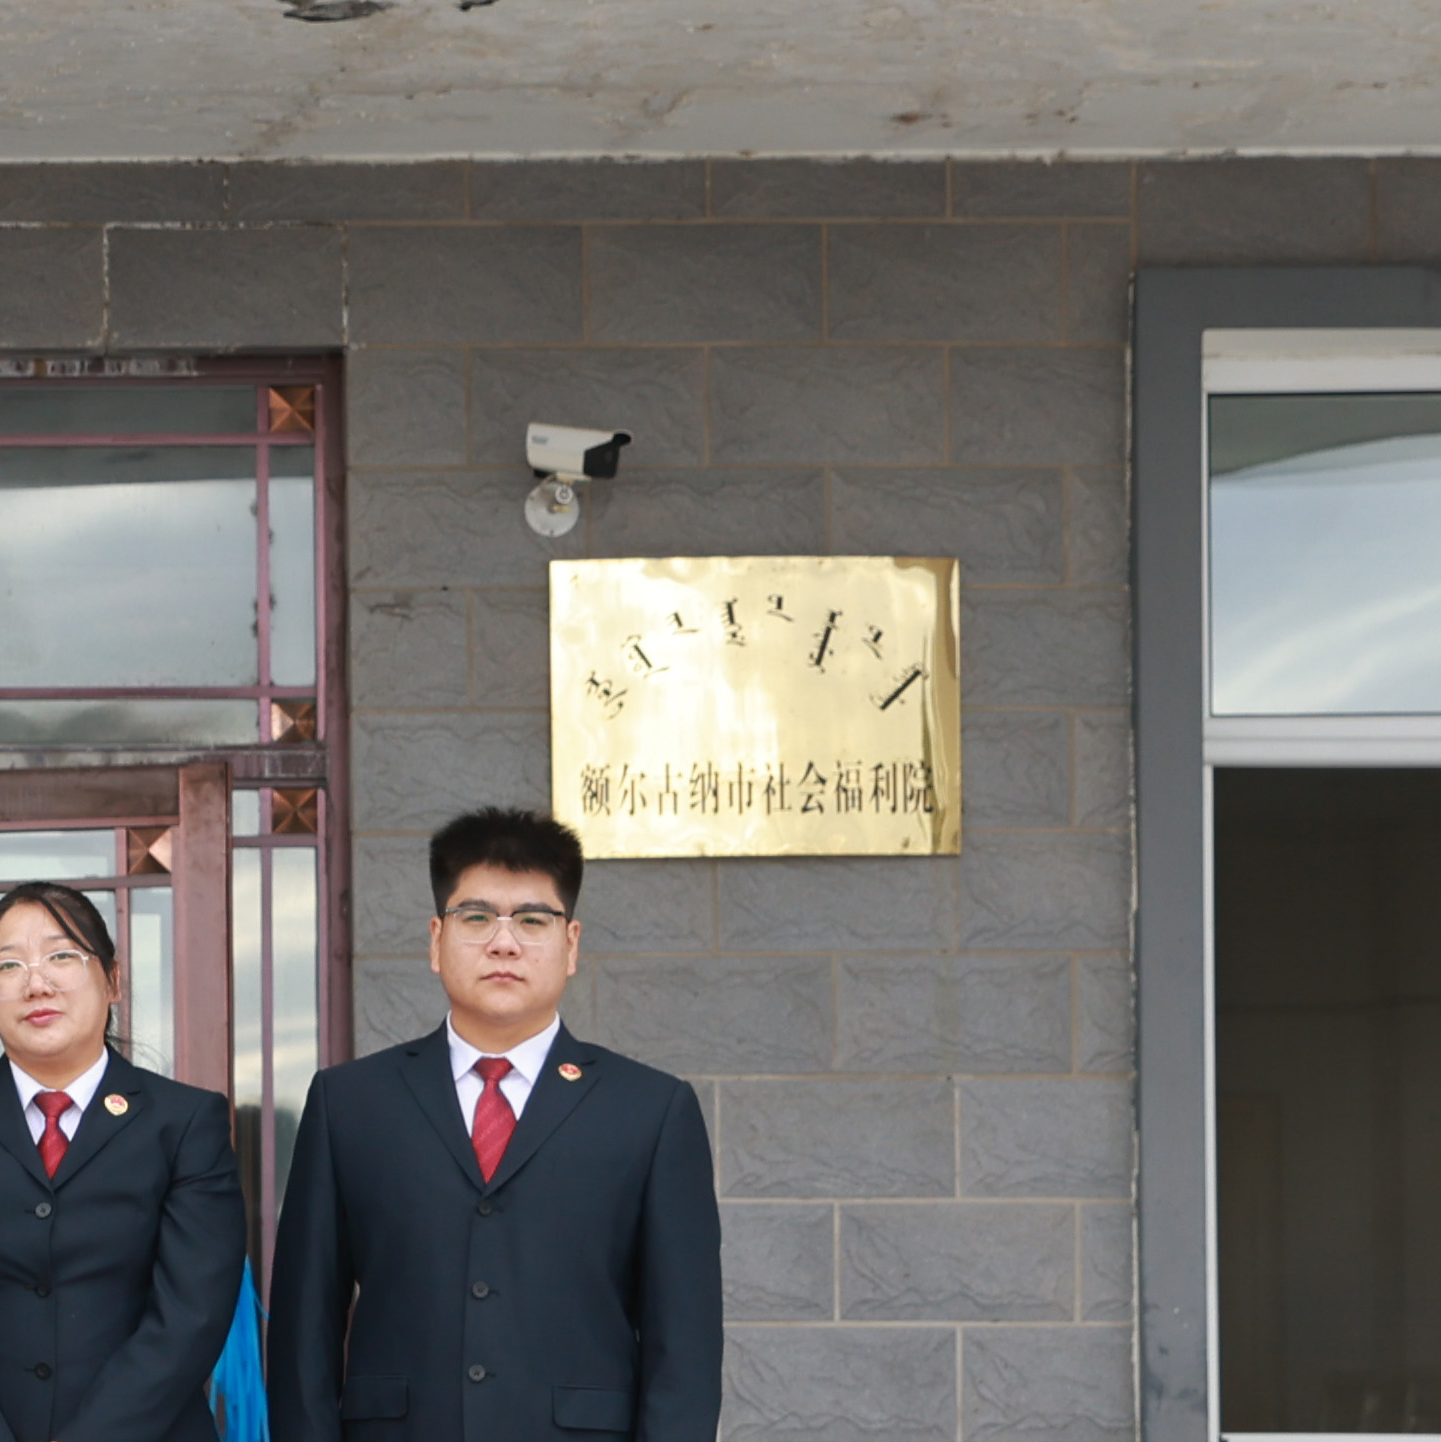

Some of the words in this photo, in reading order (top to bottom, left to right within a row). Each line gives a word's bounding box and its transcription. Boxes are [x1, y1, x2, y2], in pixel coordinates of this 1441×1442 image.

[580, 758, 935, 817] 额尔古纳市社会福利院
